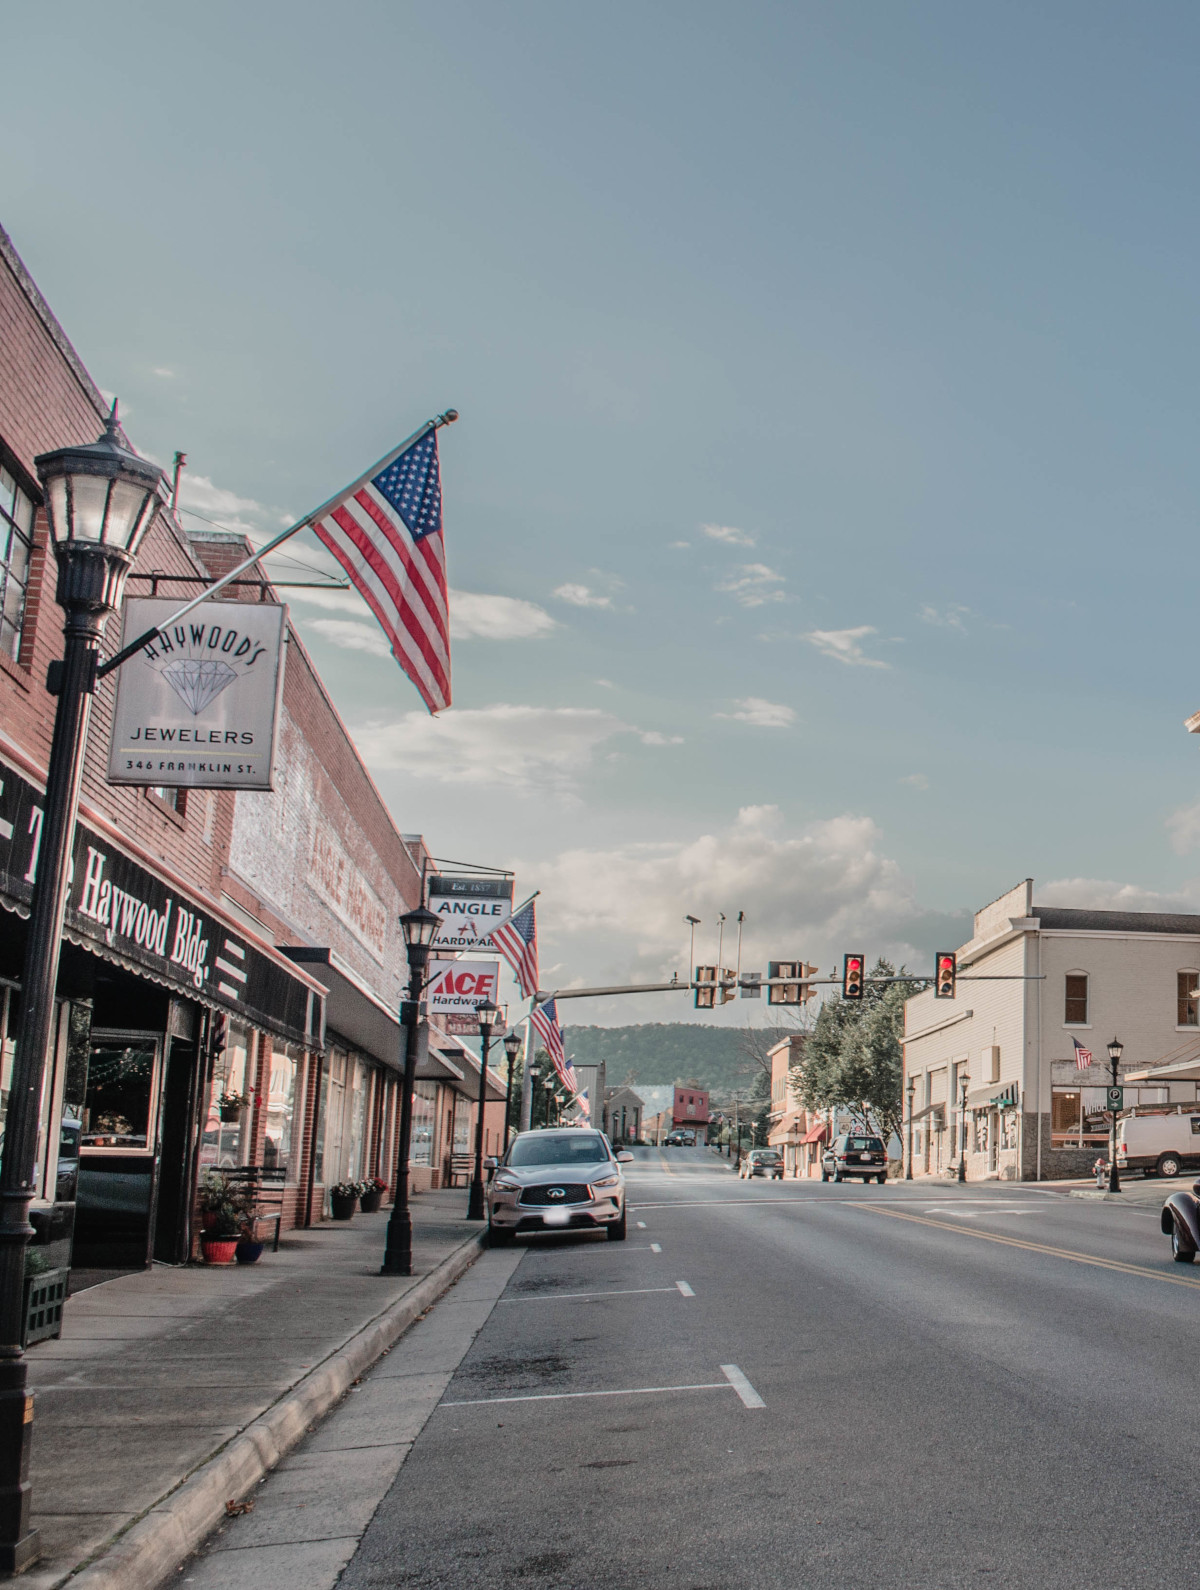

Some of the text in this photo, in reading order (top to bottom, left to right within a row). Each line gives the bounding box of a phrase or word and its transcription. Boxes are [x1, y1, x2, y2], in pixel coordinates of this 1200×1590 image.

[143, 624, 268, 665] HAYWOOD'S
[130, 727, 254, 744] JEWELERS
[126, 760, 256, 774] 346 FRANKLIN ST.
[438, 902, 502, 916] ANGLE
[79, 846, 172, 956] Haywood
[170, 906, 210, 988] Bldg.
[433, 937, 494, 947] HARDWAR
[433, 969, 495, 995] ACE
[432, 996, 484, 1006] Hardwar
